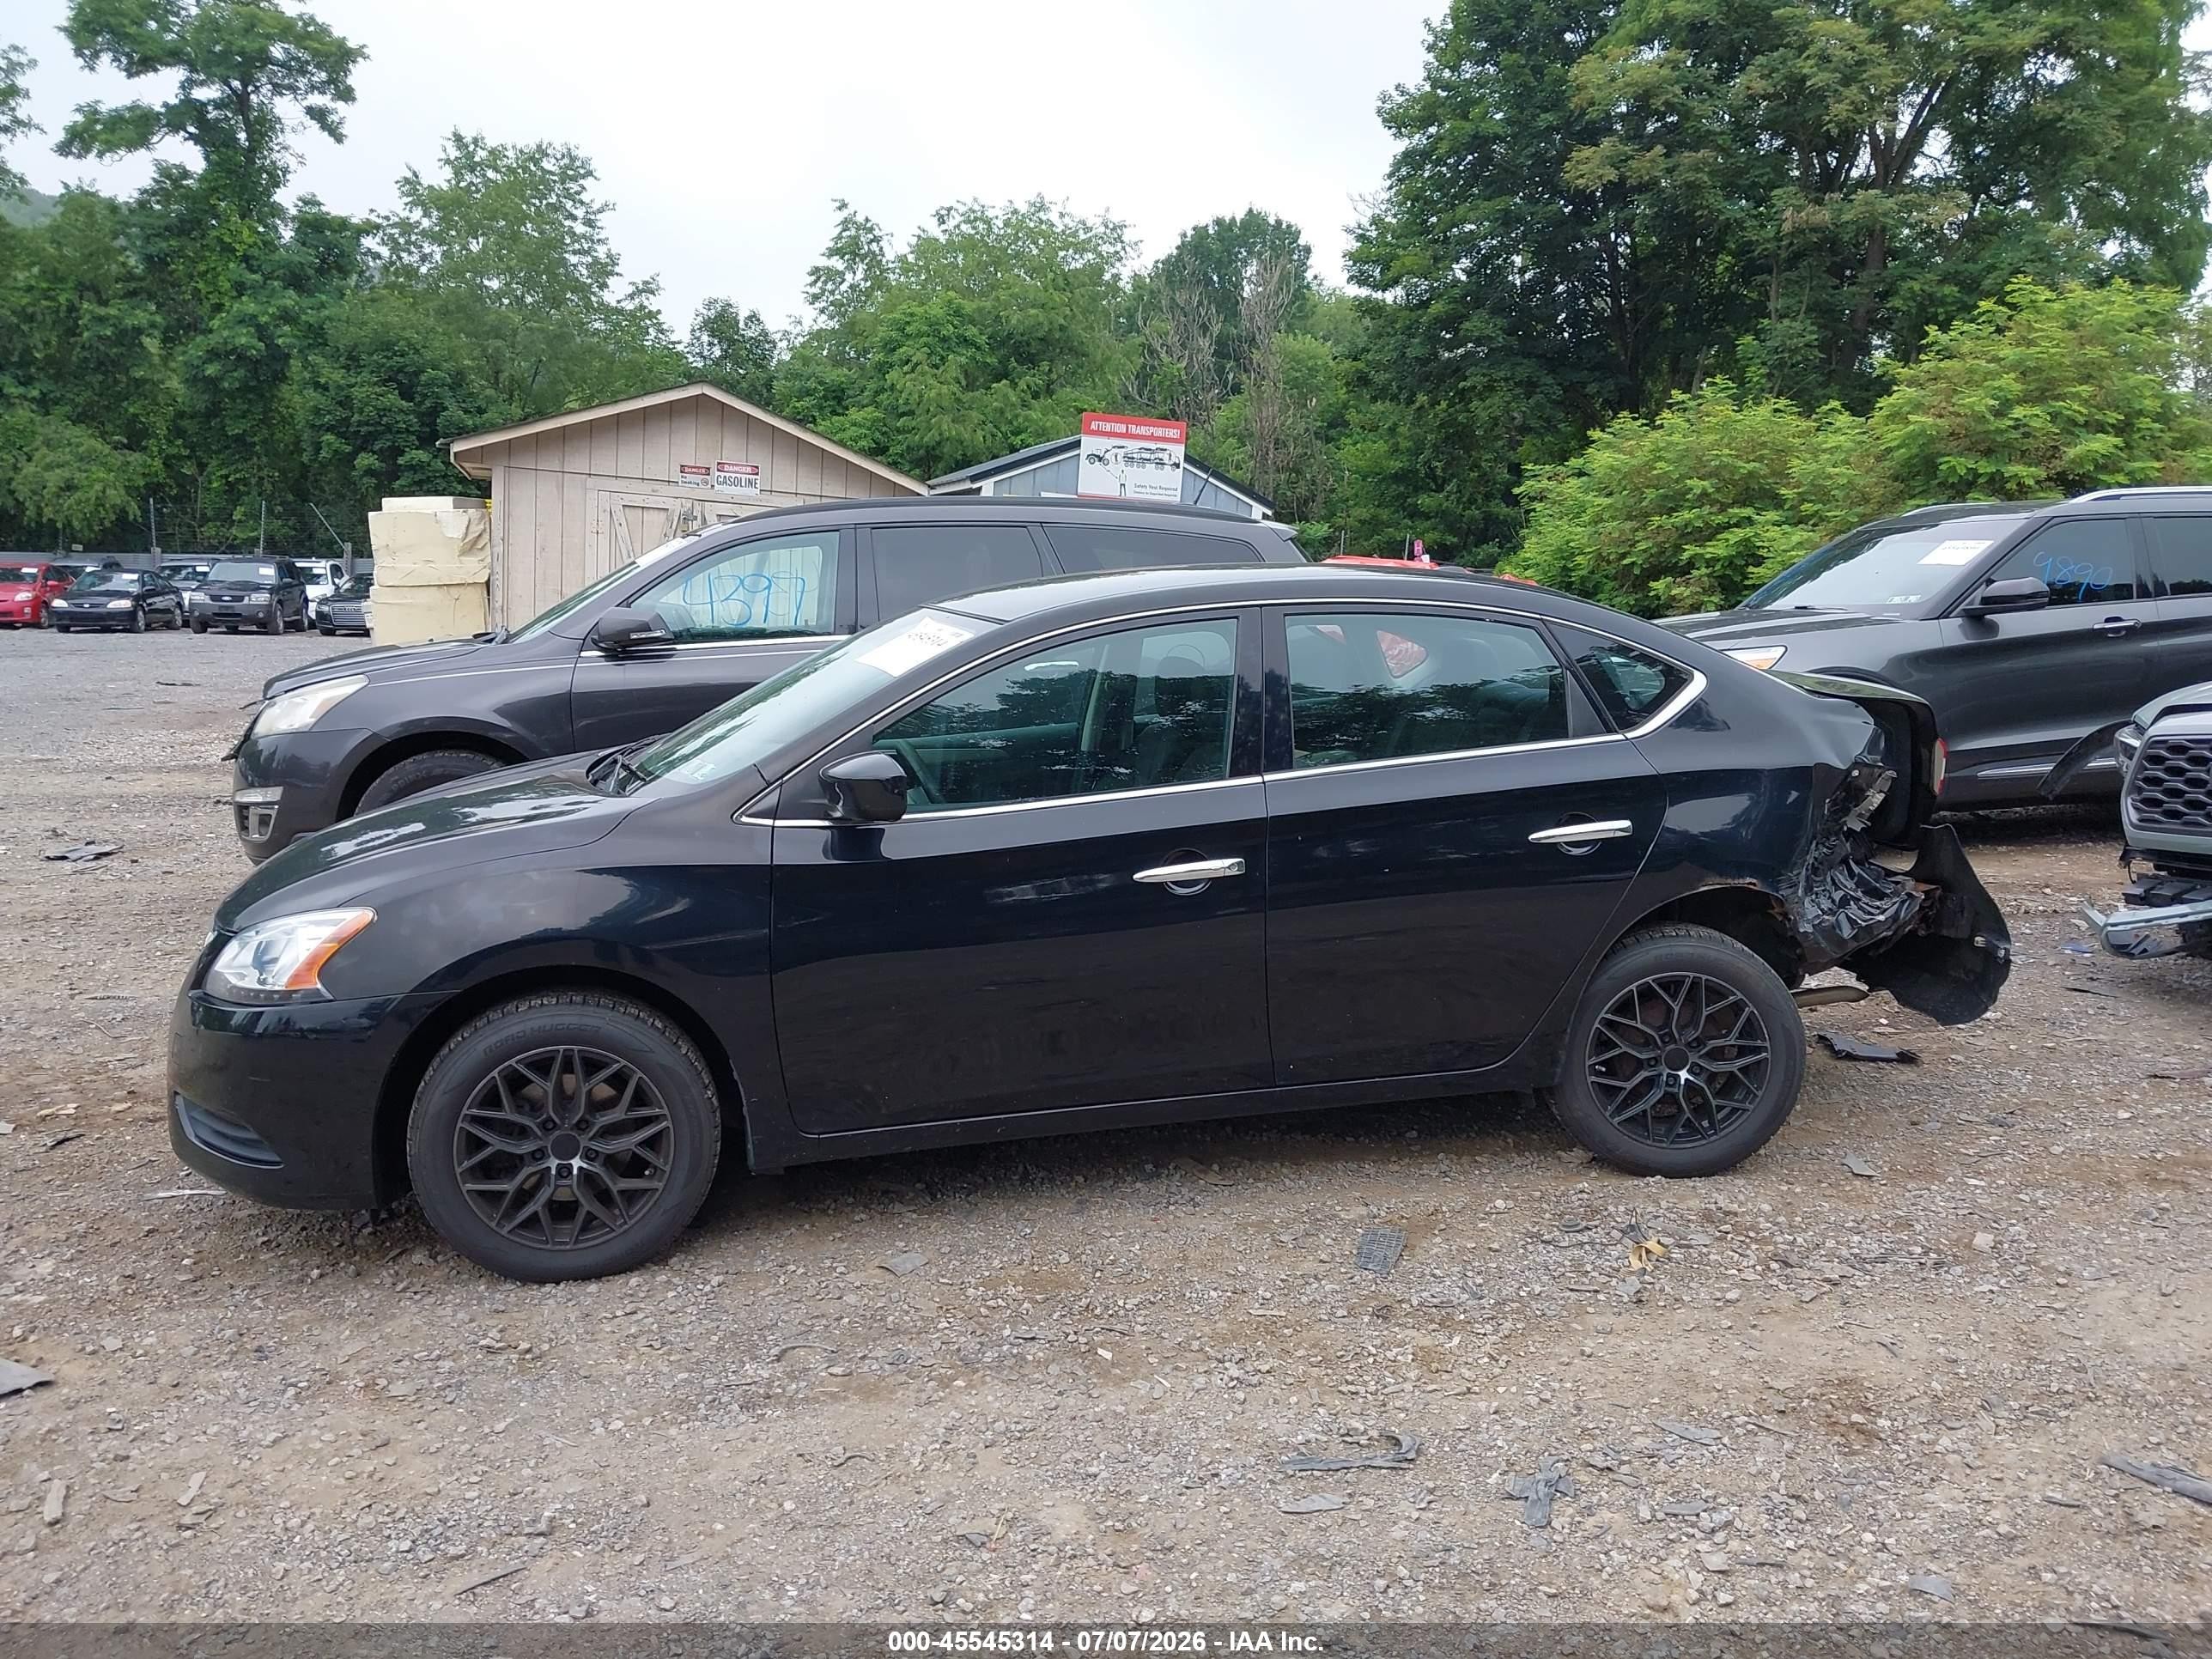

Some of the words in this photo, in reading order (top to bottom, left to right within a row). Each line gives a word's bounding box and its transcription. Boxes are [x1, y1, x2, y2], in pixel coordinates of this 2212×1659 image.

[1090, 421, 1127, 433] ATTENTION
[1127, 424, 1181, 439] TRANSPORTERS!
[724, 464, 752, 473] DANGER
[716, 474, 759, 489] GASOLINE
[2033, 551, 2113, 601] 9890
[530, 1023, 603, 1036] HUGGER
